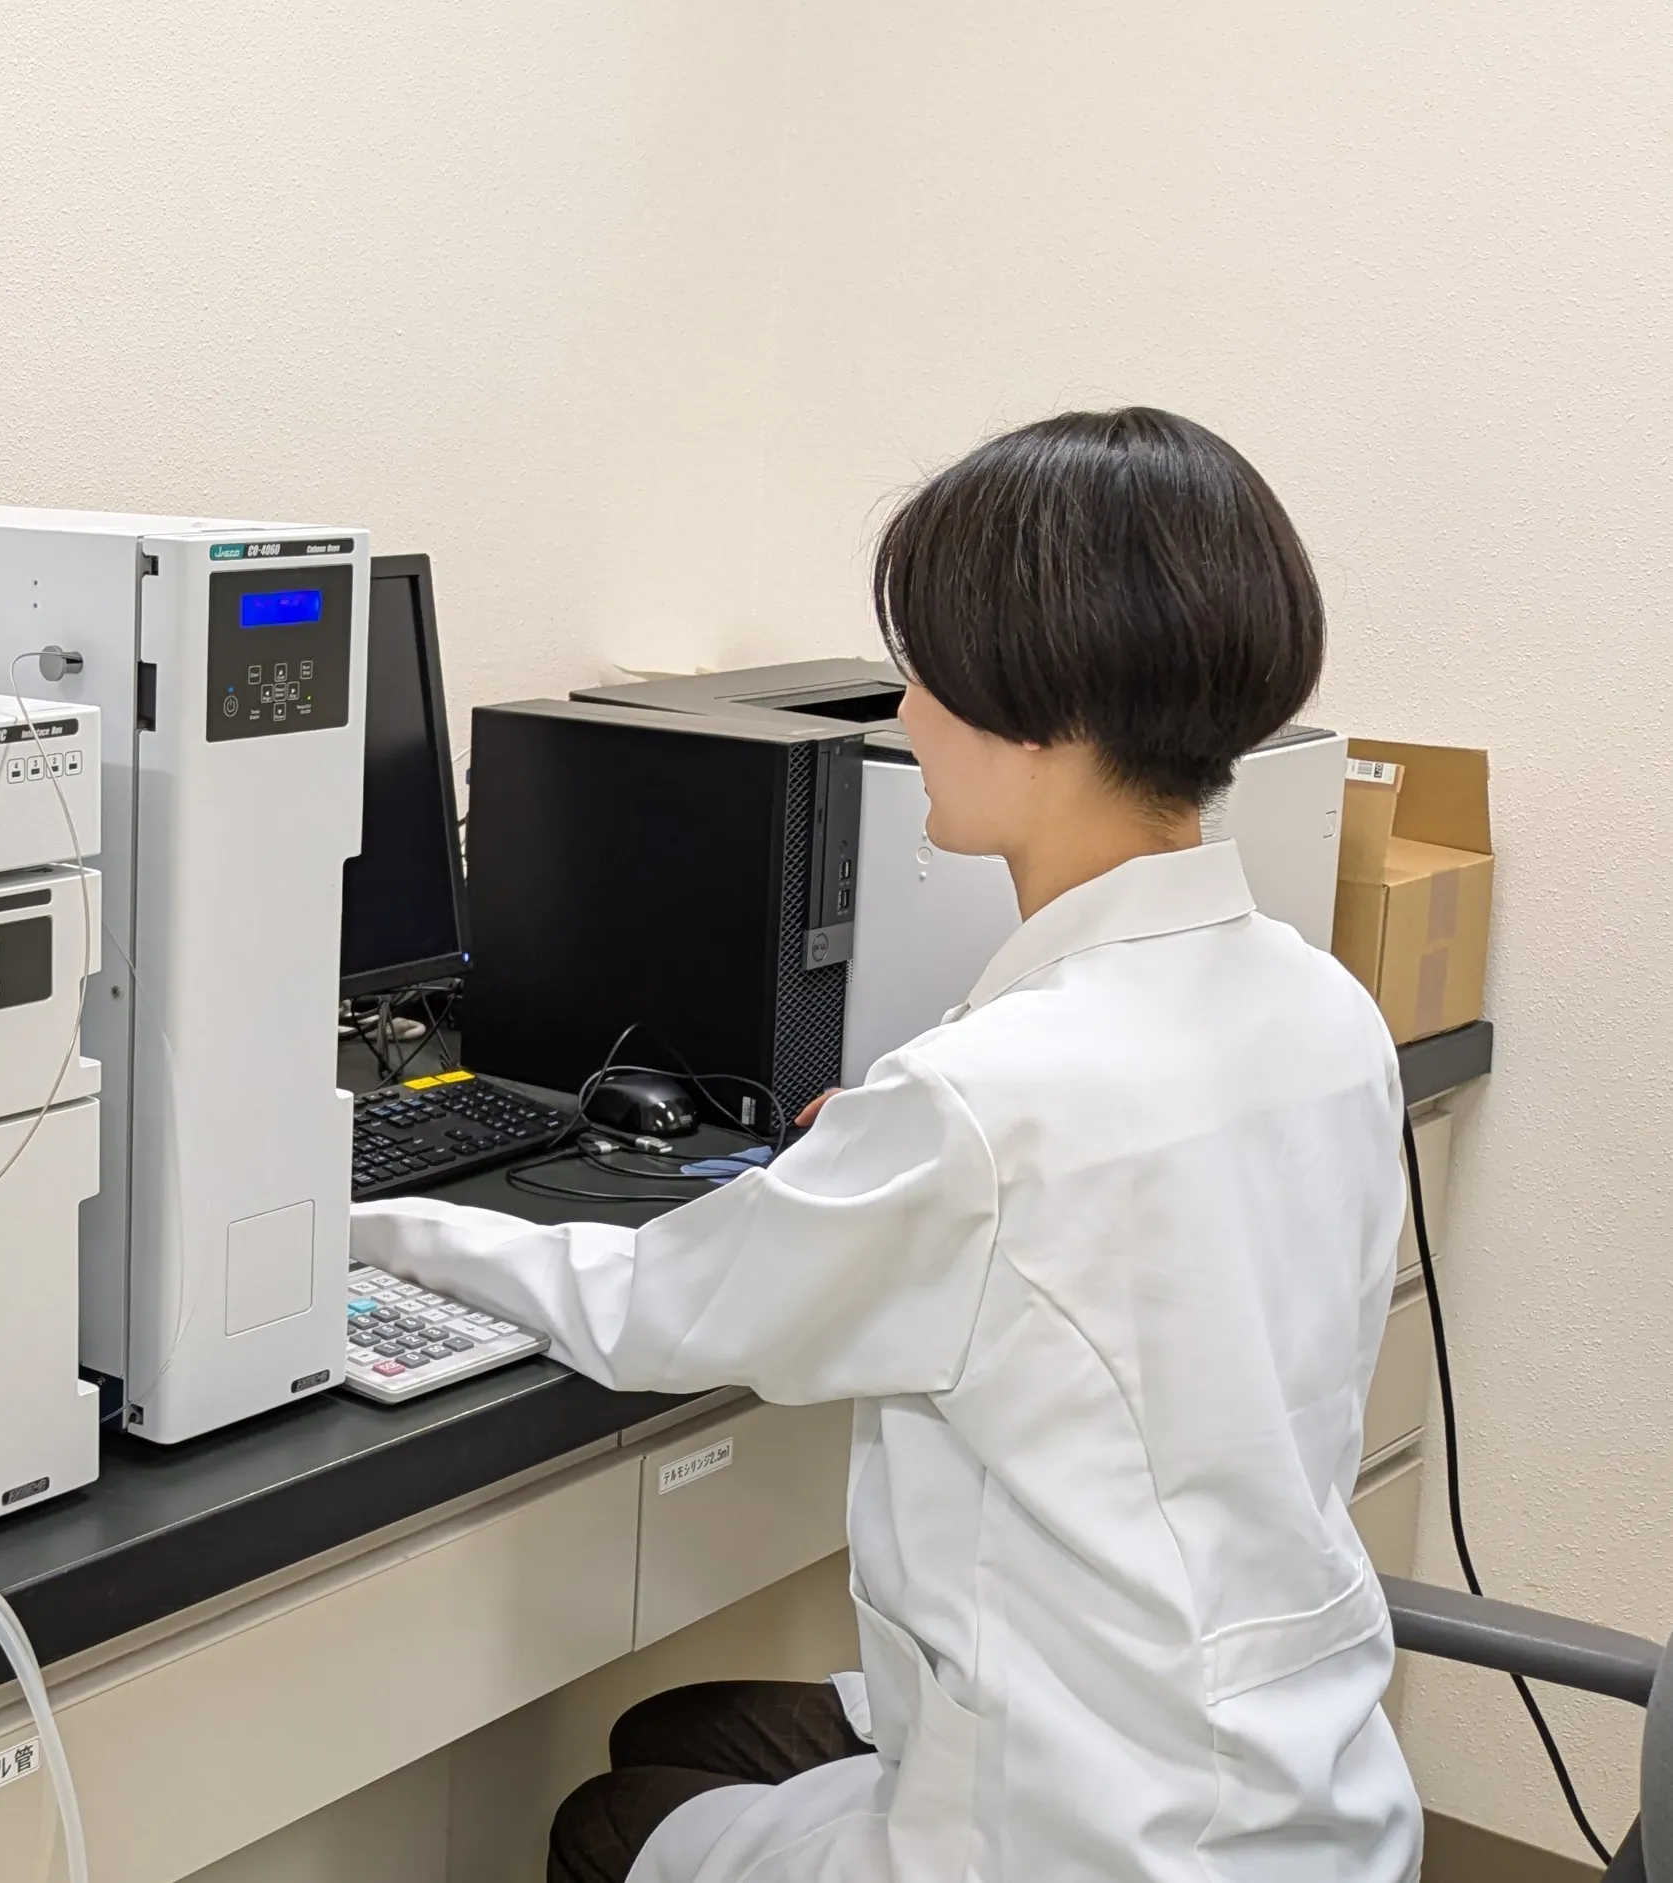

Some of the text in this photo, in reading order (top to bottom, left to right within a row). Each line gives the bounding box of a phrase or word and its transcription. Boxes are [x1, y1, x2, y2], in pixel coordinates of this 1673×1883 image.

[214, 546, 241, 558] JASCO
[247, 544, 281, 557] CO-4060
[51, 725, 63, 735] Box
[14, 762, 19, 770] 4
[34, 760, 39, 768] 3
[663, 1444, 730, 1485] テルモシリンジ2.5ml
